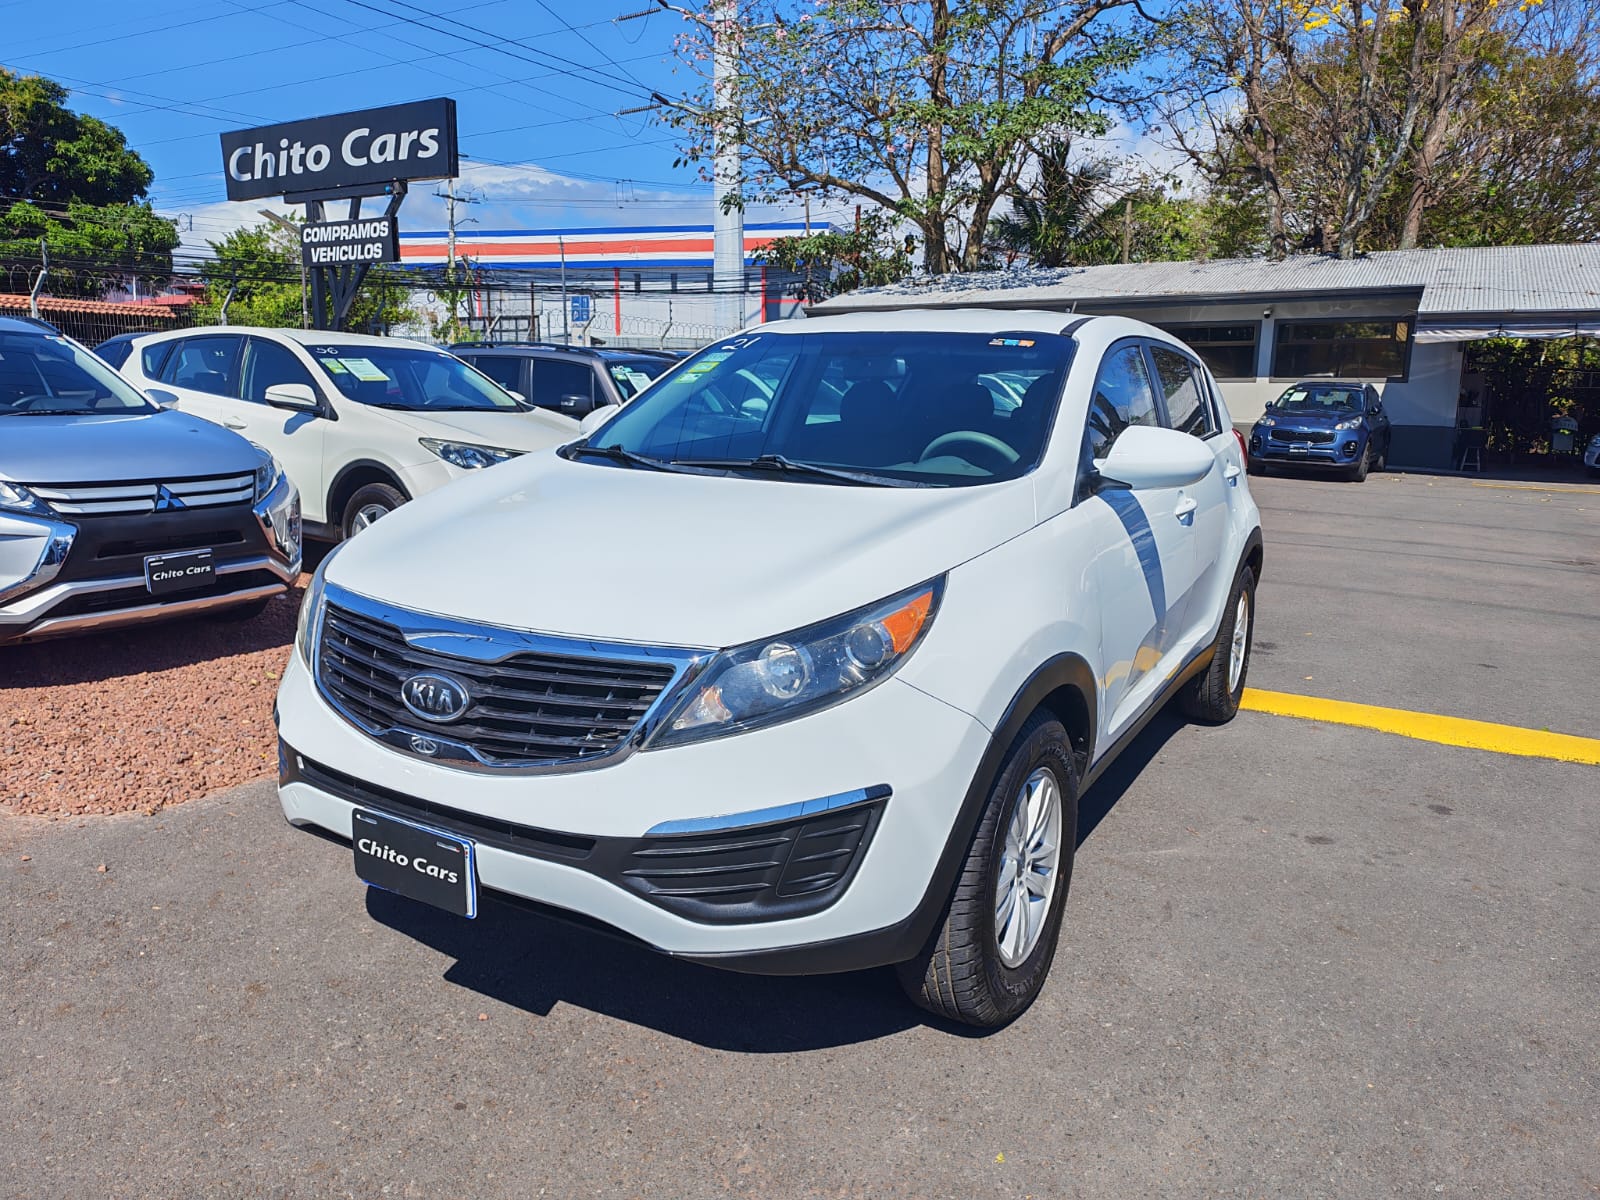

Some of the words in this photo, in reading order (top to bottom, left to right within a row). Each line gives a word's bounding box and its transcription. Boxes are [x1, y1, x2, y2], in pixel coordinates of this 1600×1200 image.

[229, 138, 331, 182] Chito
[341, 127, 439, 166] Cars
[302, 220, 389, 243] COMPRAMOS
[310, 242, 383, 263] VEHICULOS
[721, 336, 762, 350] 21
[152, 570, 183, 580] Chito
[186, 565, 211, 575] Cars
[411, 682, 453, 712] KIA
[358, 838, 409, 866] Chito
[412, 857, 458, 884] Cars
